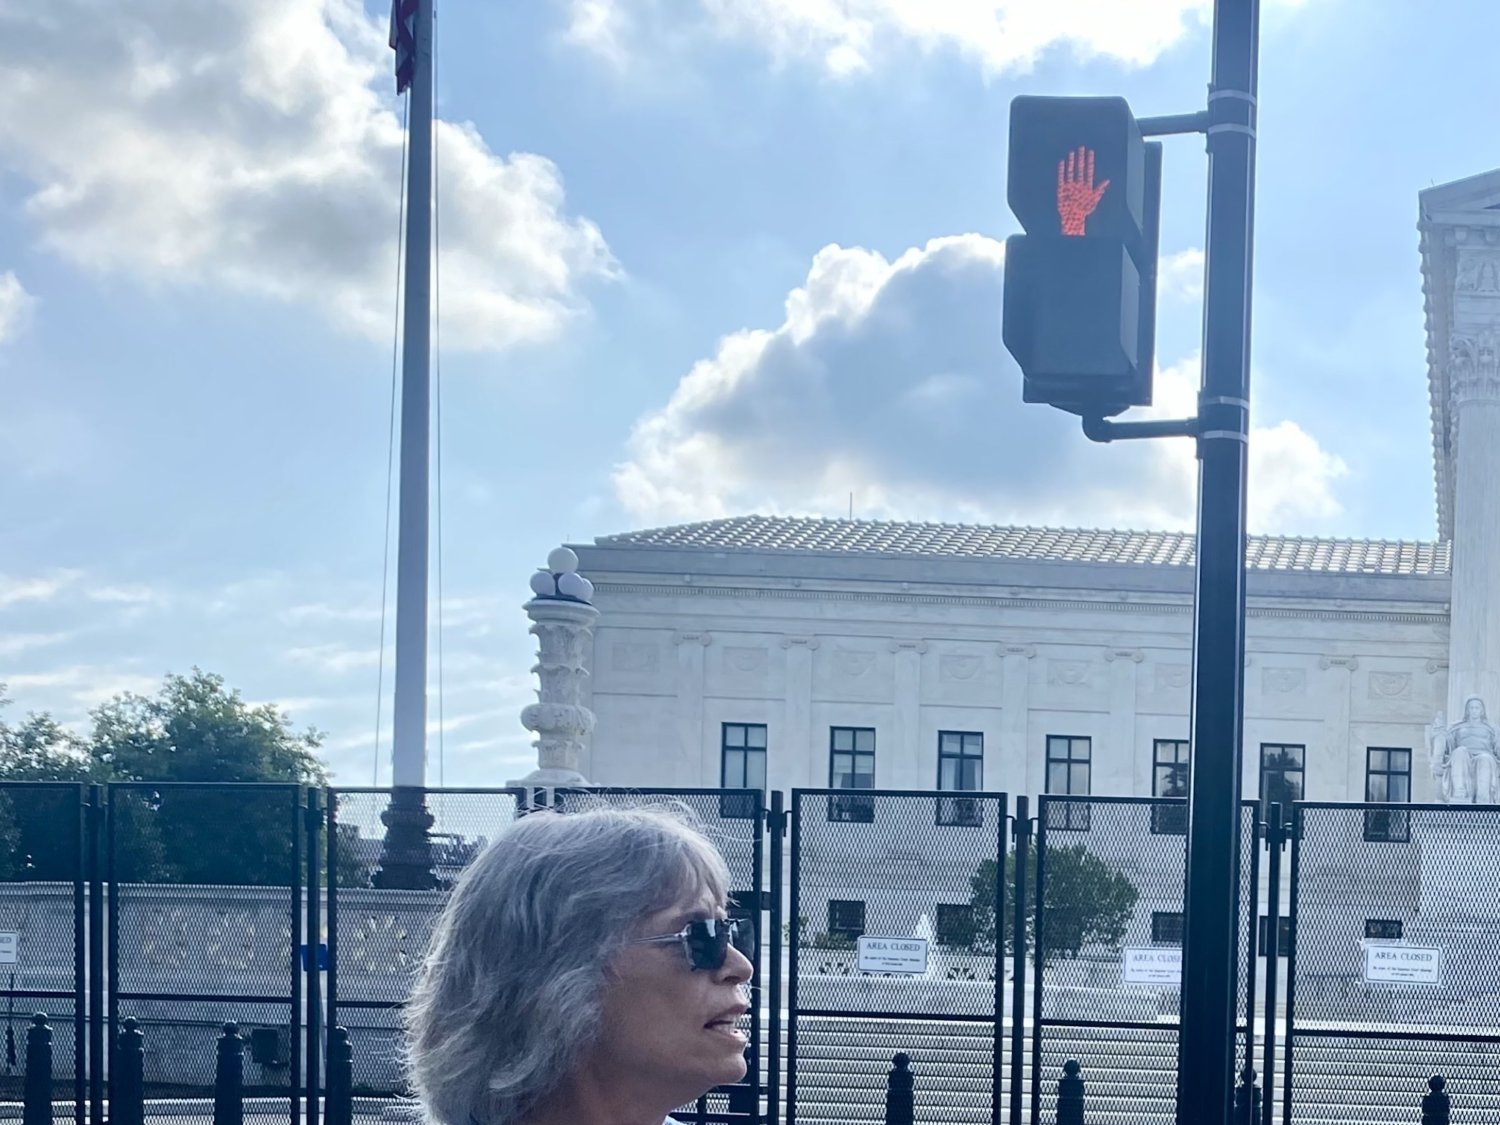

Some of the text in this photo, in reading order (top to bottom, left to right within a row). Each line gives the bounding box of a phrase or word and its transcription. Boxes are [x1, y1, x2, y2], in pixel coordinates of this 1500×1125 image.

[866, 942, 921, 951] AREA CLOSED
[1374, 951, 1433, 961] AREA CLOSED
